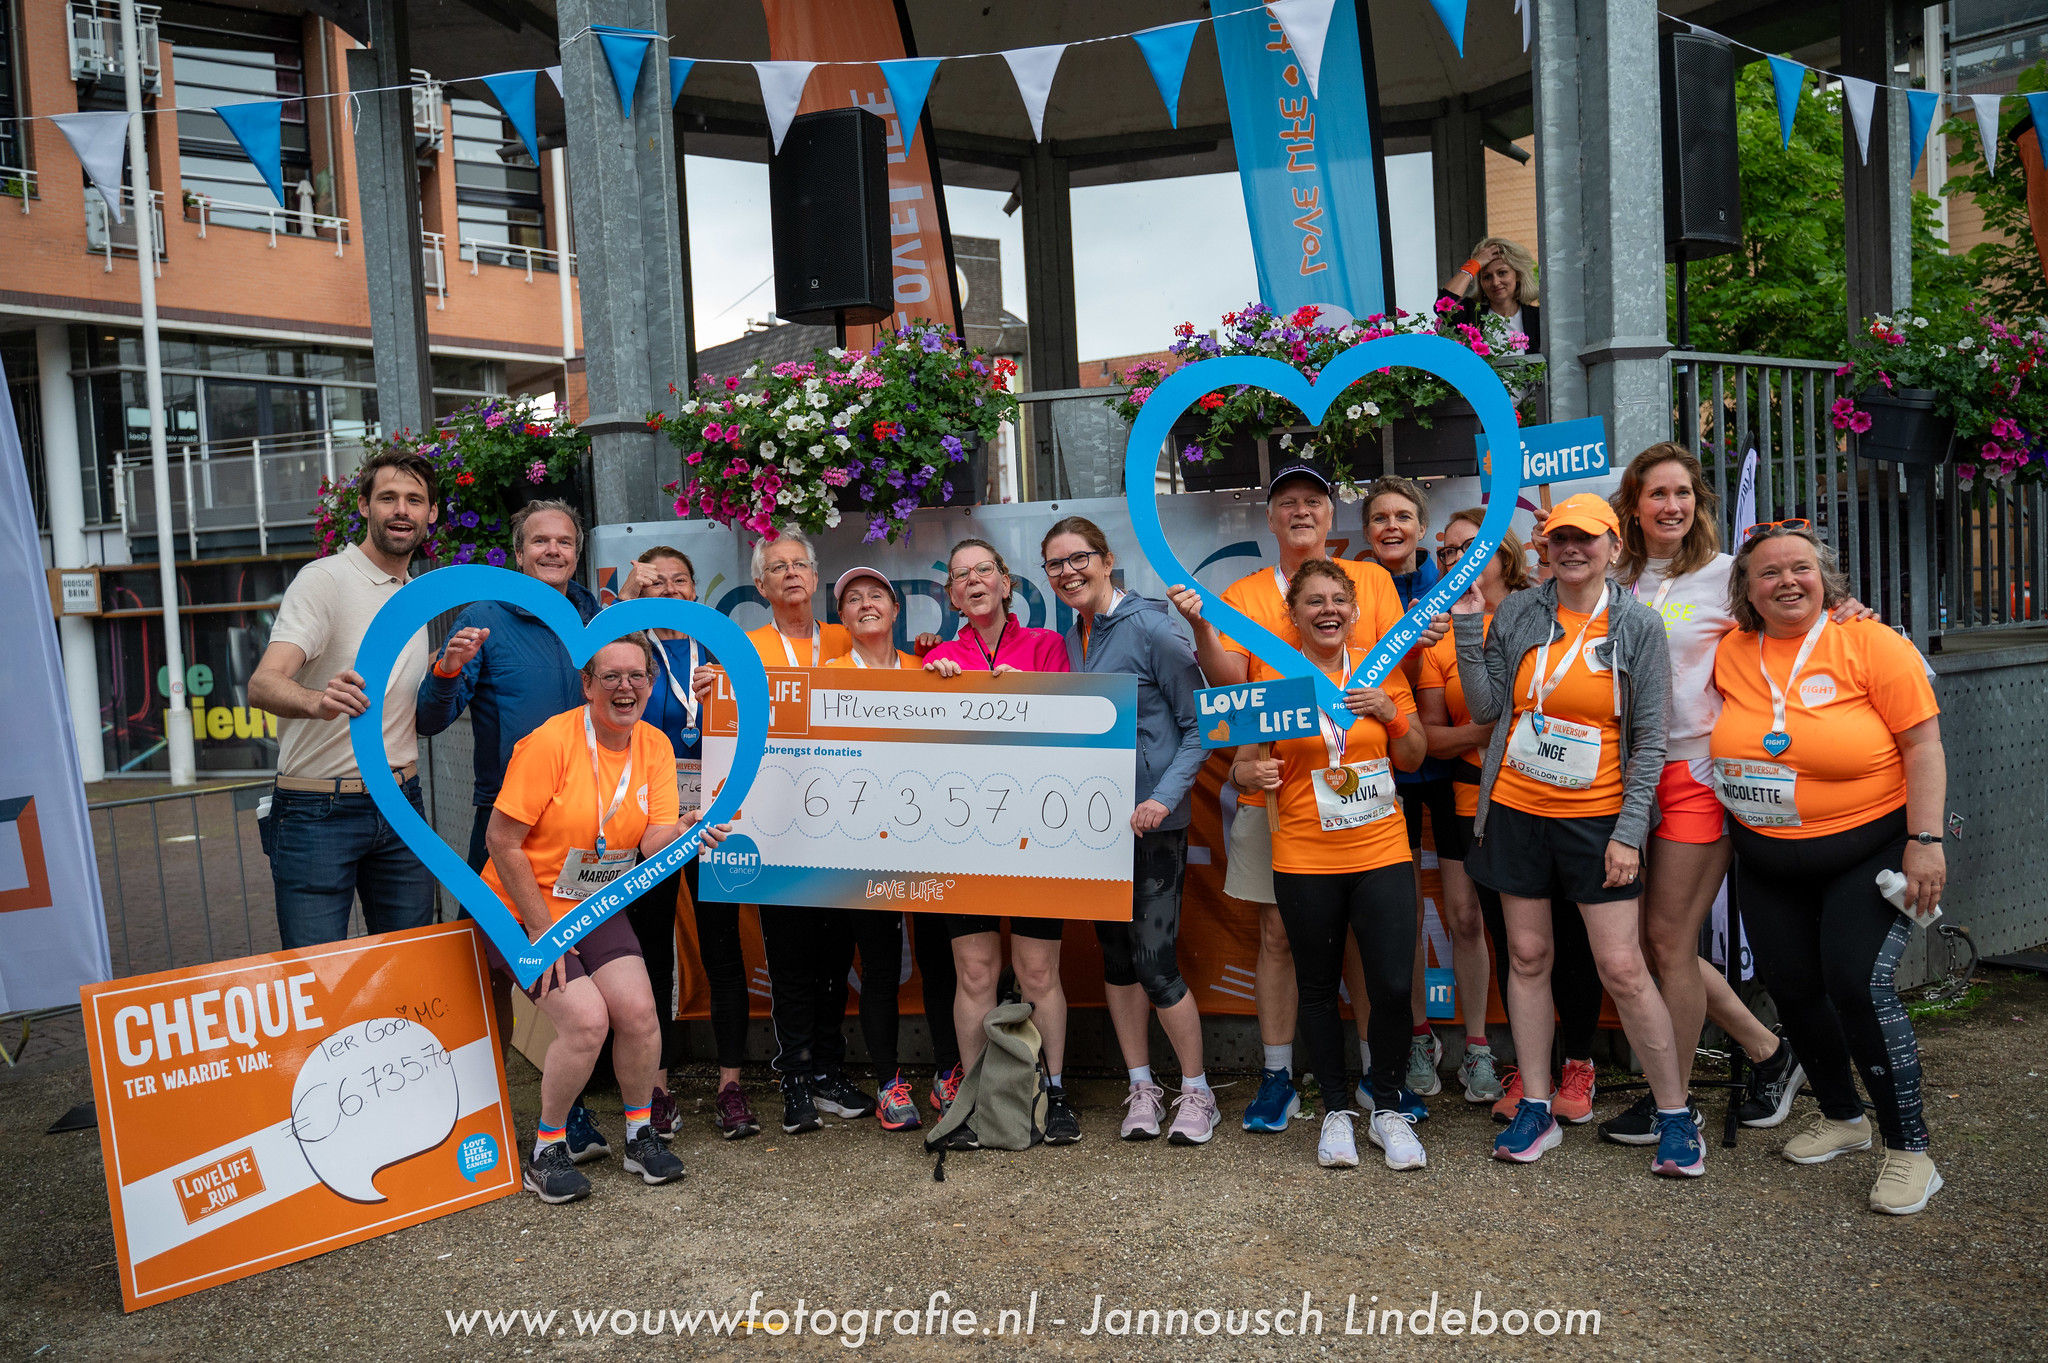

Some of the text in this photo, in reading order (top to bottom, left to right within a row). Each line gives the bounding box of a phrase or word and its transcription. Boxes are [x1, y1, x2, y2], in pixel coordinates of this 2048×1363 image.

[1358, 540, 1493, 688] Love life. Fight cancer.
[1801, 685, 1834, 695] FIGHT
[960, 700, 1028, 722] 2024
[1199, 688, 1267, 716] LOVE
[1332, 702, 1345, 710] FIG
[164, 696, 278, 740] ieu
[1259, 707, 1312, 733] LIFE
[1552, 723, 1588, 738] HILVERSUM
[763, 744, 863, 758] pbrengst donaties
[1537, 741, 1567, 762] INGE
[1525, 766, 1558, 781] SCILDON
[1744, 764, 1780, 775] HILVERSUM
[1722, 783, 1782, 804] NICOLETTE
[713, 851, 759, 866] FIGHT
[577, 869, 622, 883] MARGOT
[729, 867, 755, 875] cancer
[865, 879, 944, 901] LOVE LIFE
[551, 914, 593, 949] Love
[590, 893, 625, 918] life.
[623, 860, 667, 895] Fight
[519, 957, 542, 965] FIGHT
[1429, 984, 1452, 1003] IT!
[114, 972, 324, 1067] CHEQUE
[124, 1051, 273, 1099] TER WAARDE VAN:
[463, 1138, 487, 1150] LOVE
[465, 1150, 493, 1164] FIGHT
[207, 1182, 238, 1211] RUN
